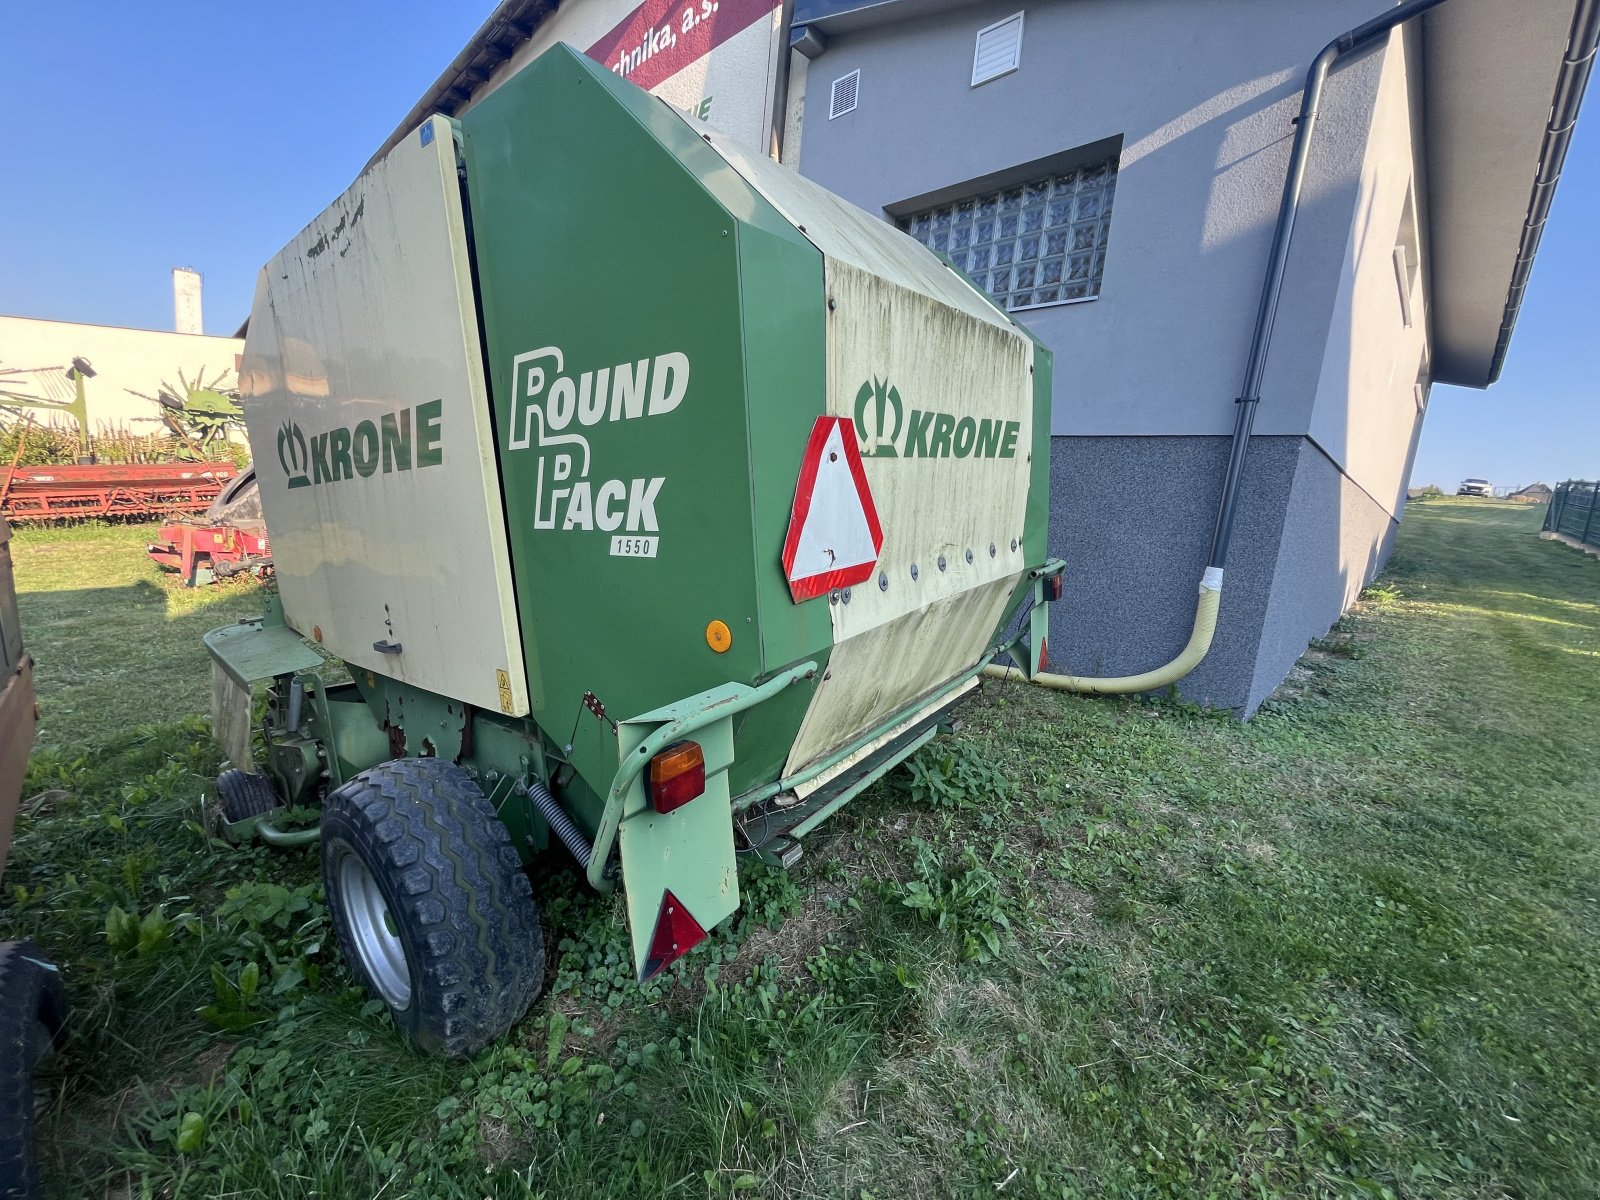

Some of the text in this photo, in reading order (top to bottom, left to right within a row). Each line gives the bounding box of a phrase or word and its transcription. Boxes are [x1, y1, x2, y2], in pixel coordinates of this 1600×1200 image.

[681, 0, 719, 34] a.s.
[508, 346, 690, 451] ROUND
[310, 399, 443, 486] KRONE
[903, 409, 1021, 459] KRONE
[533, 433, 666, 532] PACK
[617, 539, 650, 555] 1550
